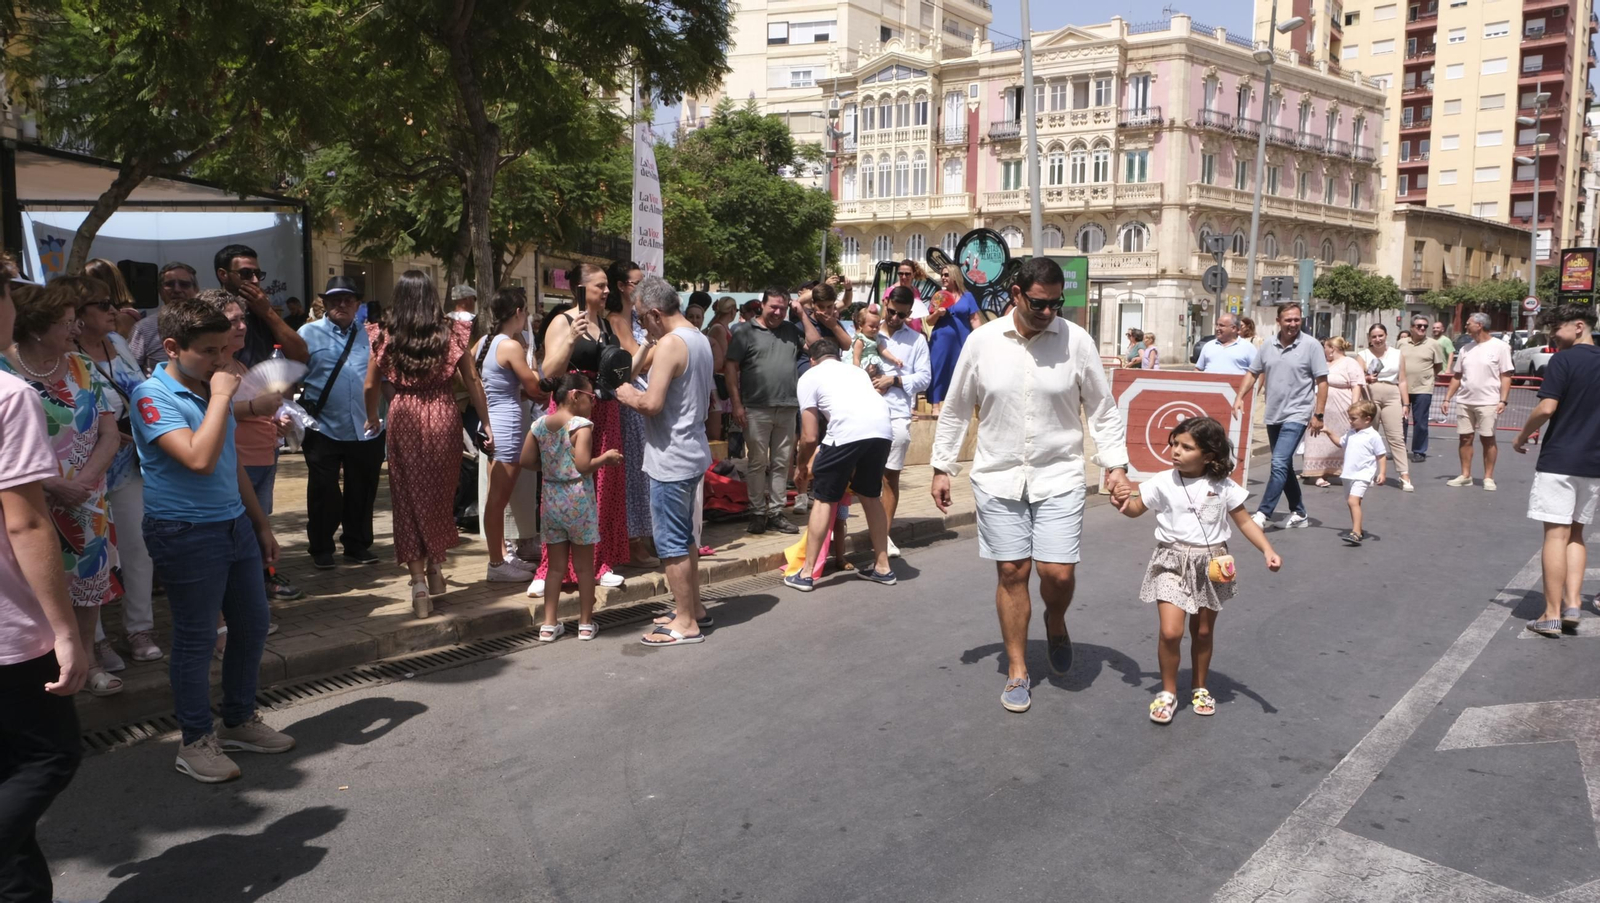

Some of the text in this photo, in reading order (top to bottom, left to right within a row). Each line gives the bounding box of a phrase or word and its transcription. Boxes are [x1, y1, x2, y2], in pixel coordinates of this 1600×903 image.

[639, 191, 649, 202] La
[638, 202, 648, 213] de
[639, 226, 660, 239] La Voz
[638, 236, 648, 247] de
[137, 396, 161, 425] 6
